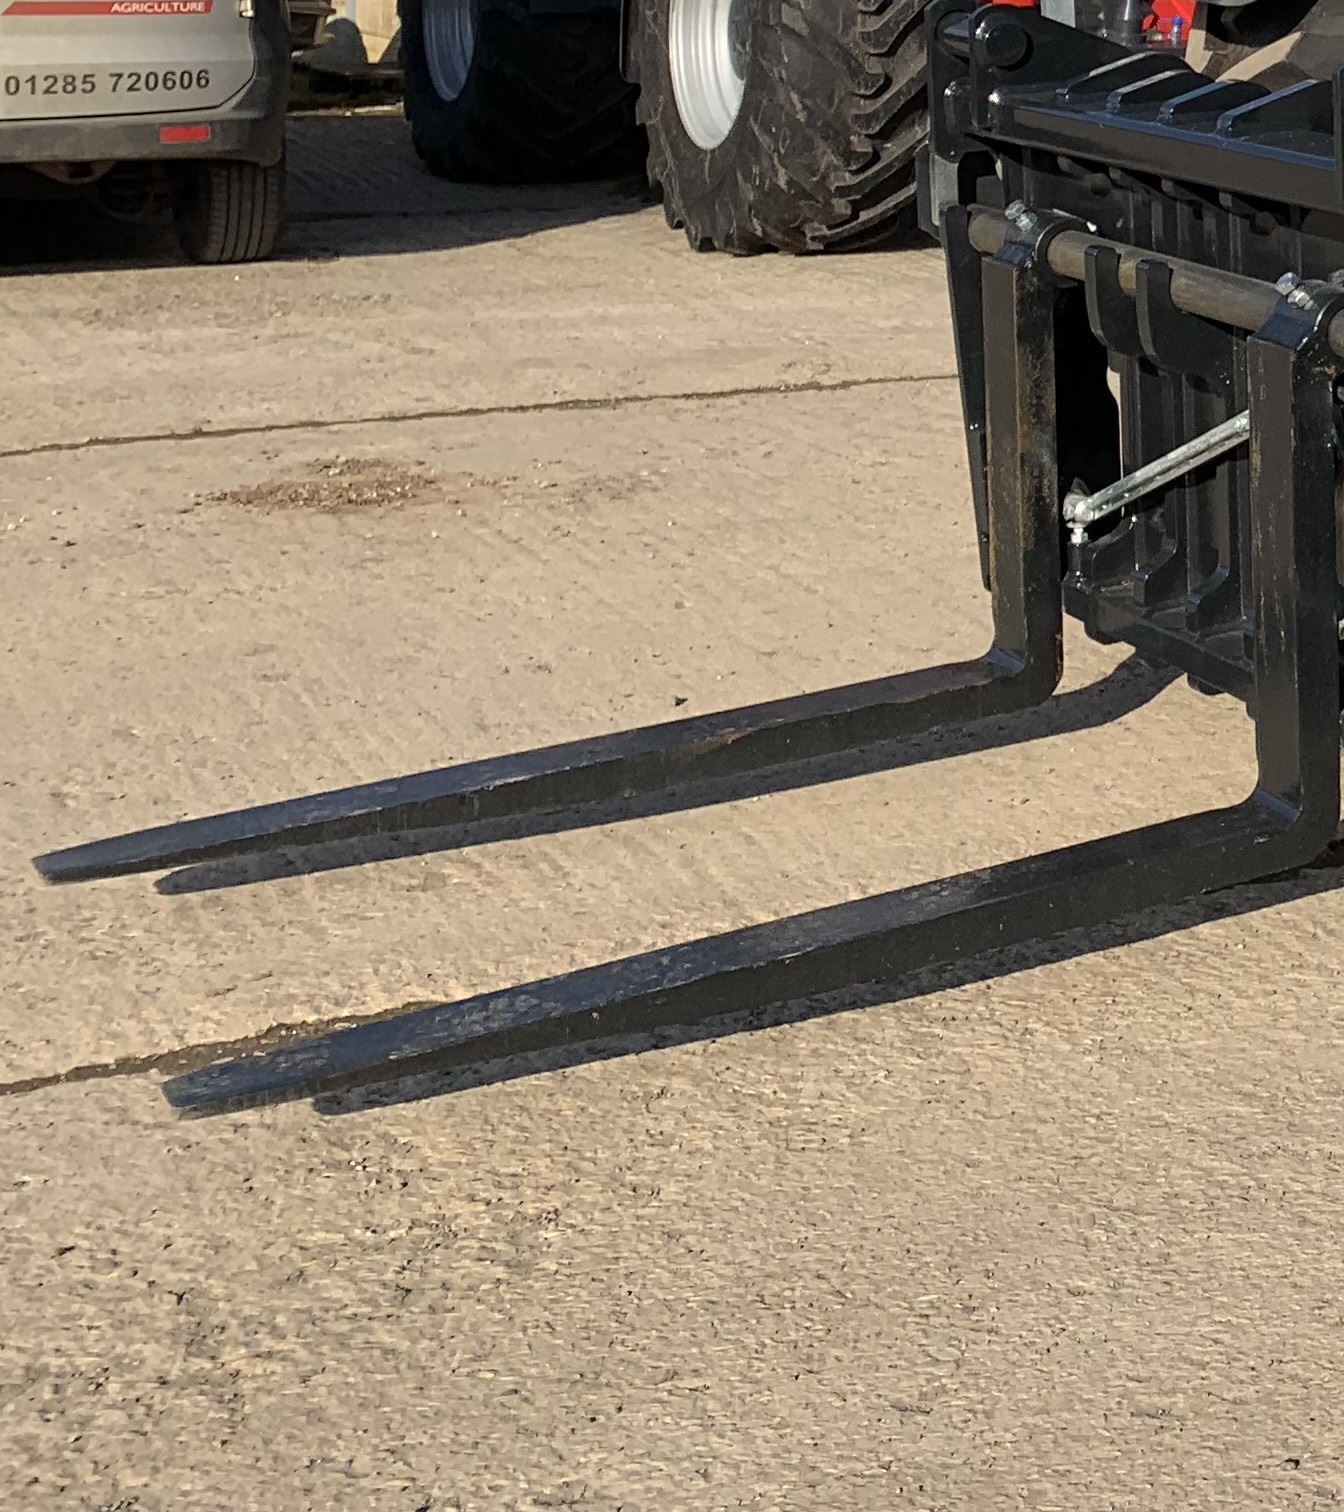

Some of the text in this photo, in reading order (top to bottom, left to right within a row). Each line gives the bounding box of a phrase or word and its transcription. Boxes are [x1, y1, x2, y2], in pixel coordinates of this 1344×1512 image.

[110, 1, 205, 13] AGRICULTURE
[4, 68, 211, 96] 01285 720606
